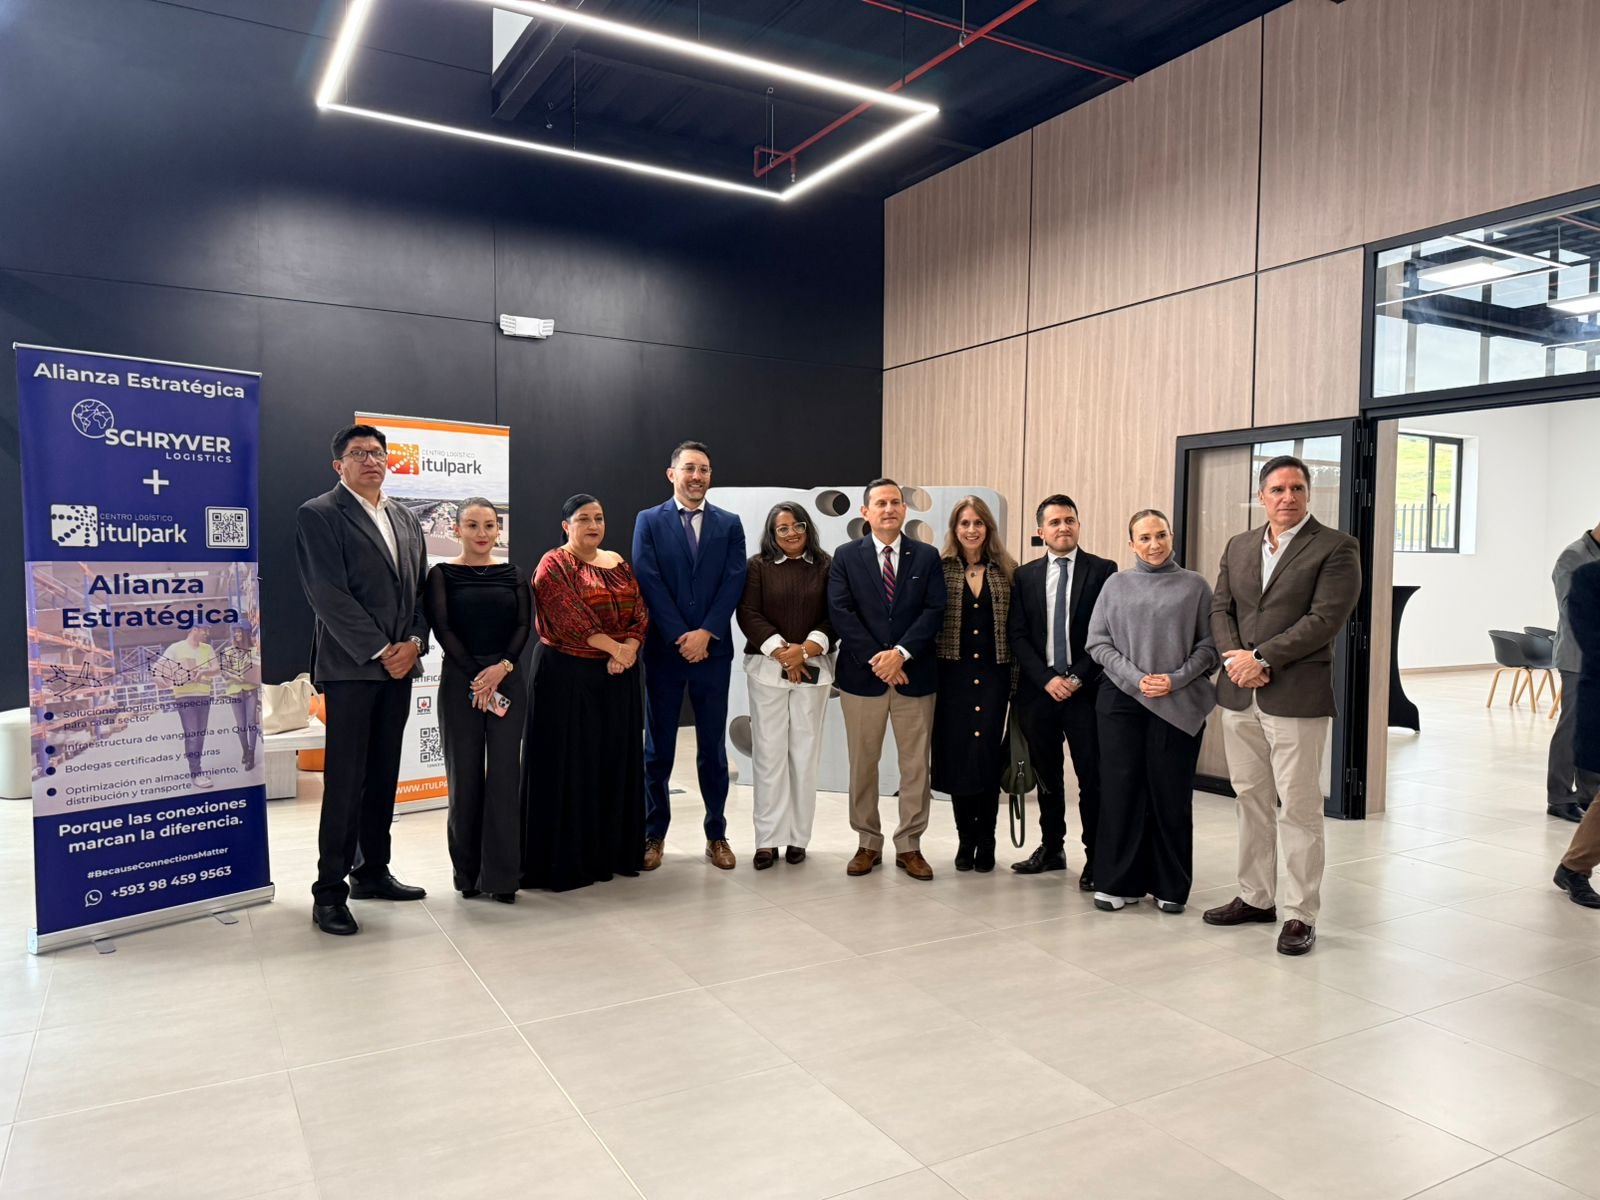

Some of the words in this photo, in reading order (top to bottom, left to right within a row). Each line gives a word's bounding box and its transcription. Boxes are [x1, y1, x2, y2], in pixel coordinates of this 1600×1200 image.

[33, 362, 120, 386] Alianza
[127, 372, 245, 399] Estratégica
[105, 428, 231, 453] SCHRYVER
[166, 452, 232, 463] LOGISTICS
[422, 456, 482, 477] itulpark
[100, 513, 133, 521] CENTRO
[100, 521, 187, 548] itulpark
[88, 572, 204, 595] Alianza
[62, 603, 239, 630] Estratégica
[63, 706, 121, 719] Soluciones
[173, 697, 242, 709] especializadas
[63, 721, 87, 731] para
[90, 718, 115, 727] cada
[118, 714, 150, 724] sector
[64, 735, 143, 752] Infraestructura
[144, 733, 159, 743] de
[160, 728, 215, 742] vanguardia
[65, 761, 112, 774] Bodegas
[115, 752, 174, 768] certificadas
[175, 752, 182, 761] y
[183, 748, 221, 761] seguras
[65, 778, 137, 797] Optimización
[138, 777, 153, 785] en
[154, 766, 239, 783] almacenamiento,
[66, 790, 130, 807] distribución
[131, 789, 139, 799] y
[140, 781, 193, 797] transporte
[58, 816, 124, 838] Porque
[128, 812, 152, 827] las
[156, 798, 247, 822] conexiones
[68, 833, 136, 853] marcan
[140, 829, 156, 841] la
[159, 814, 244, 838] diferencia.
[87, 846, 229, 879] #BecauseConnectionsMatter
[110, 881, 146, 898] +593
[149, 879, 168, 892] 98
[170, 872, 197, 889] 459
[199, 864, 233, 881] 9563
